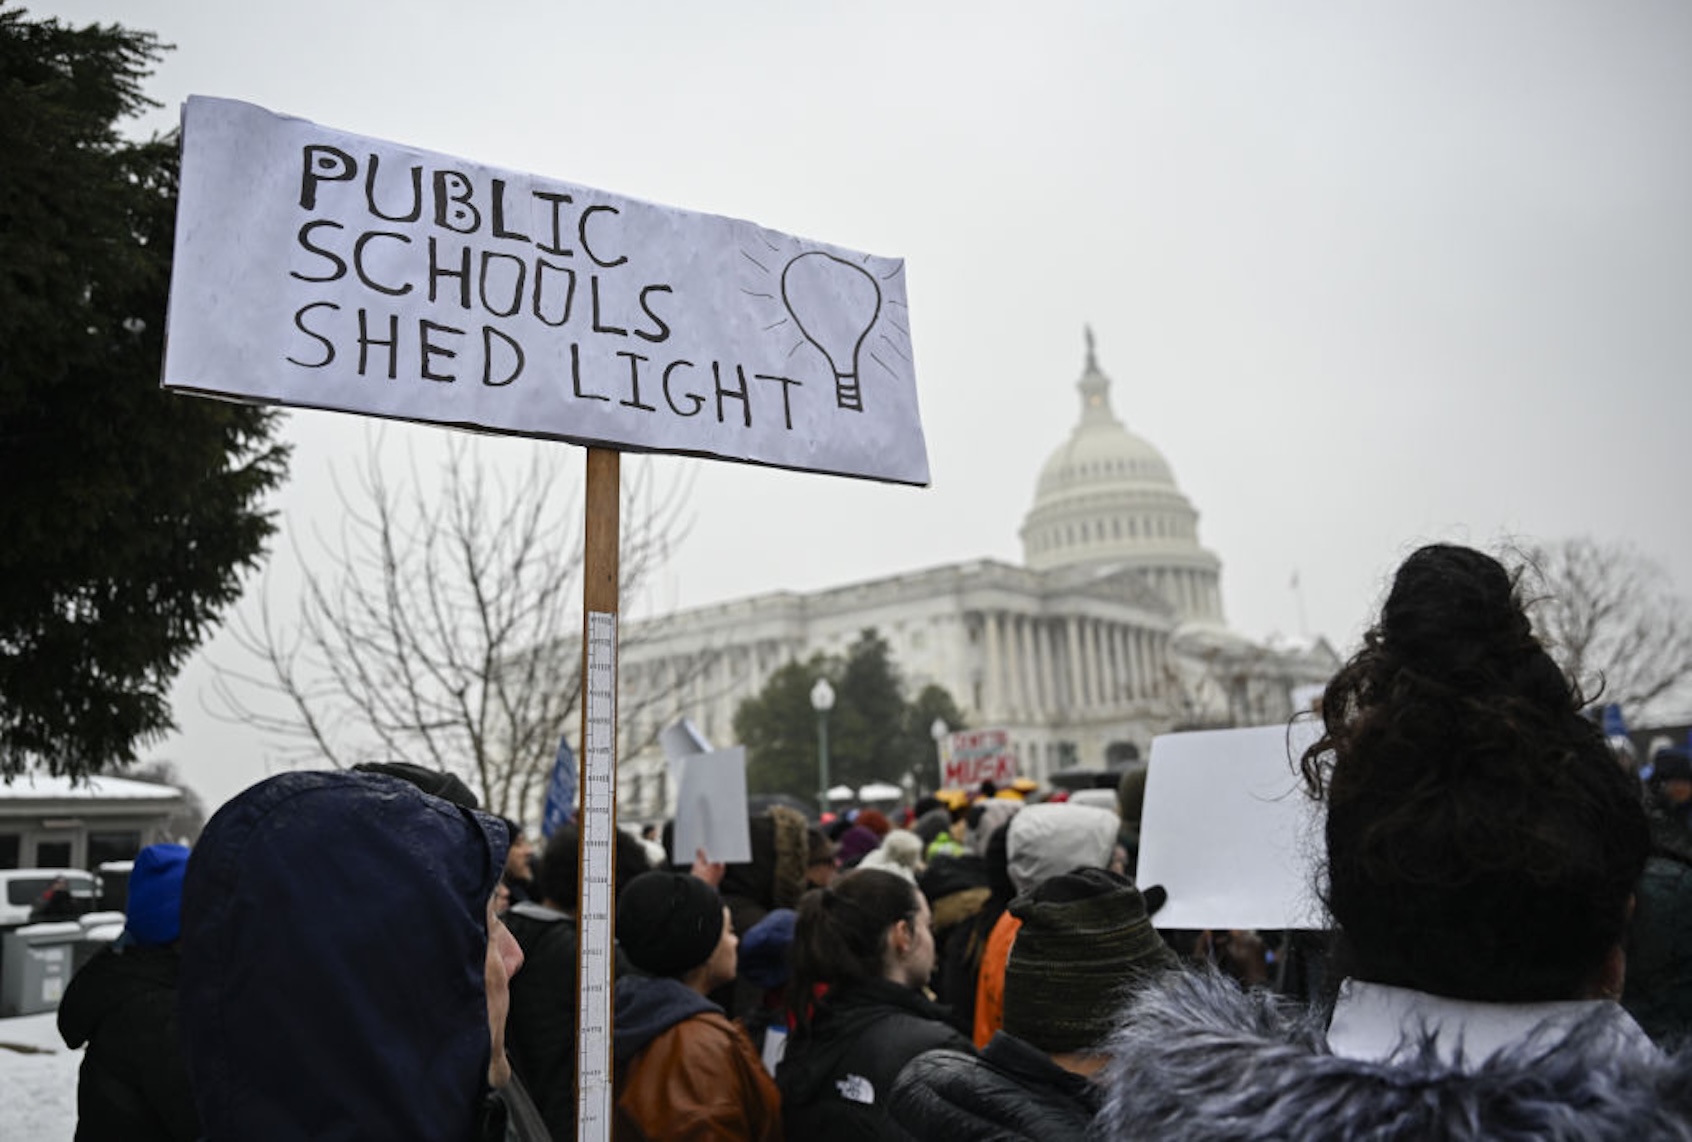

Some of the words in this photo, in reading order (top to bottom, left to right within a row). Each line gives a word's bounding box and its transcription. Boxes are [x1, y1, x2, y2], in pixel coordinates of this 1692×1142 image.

[298, 144, 629, 268] PUBLIC
[289, 219, 673, 343] SCHOOLS
[286, 301, 525, 388] SHED
[570, 342, 803, 430] LIGHT
